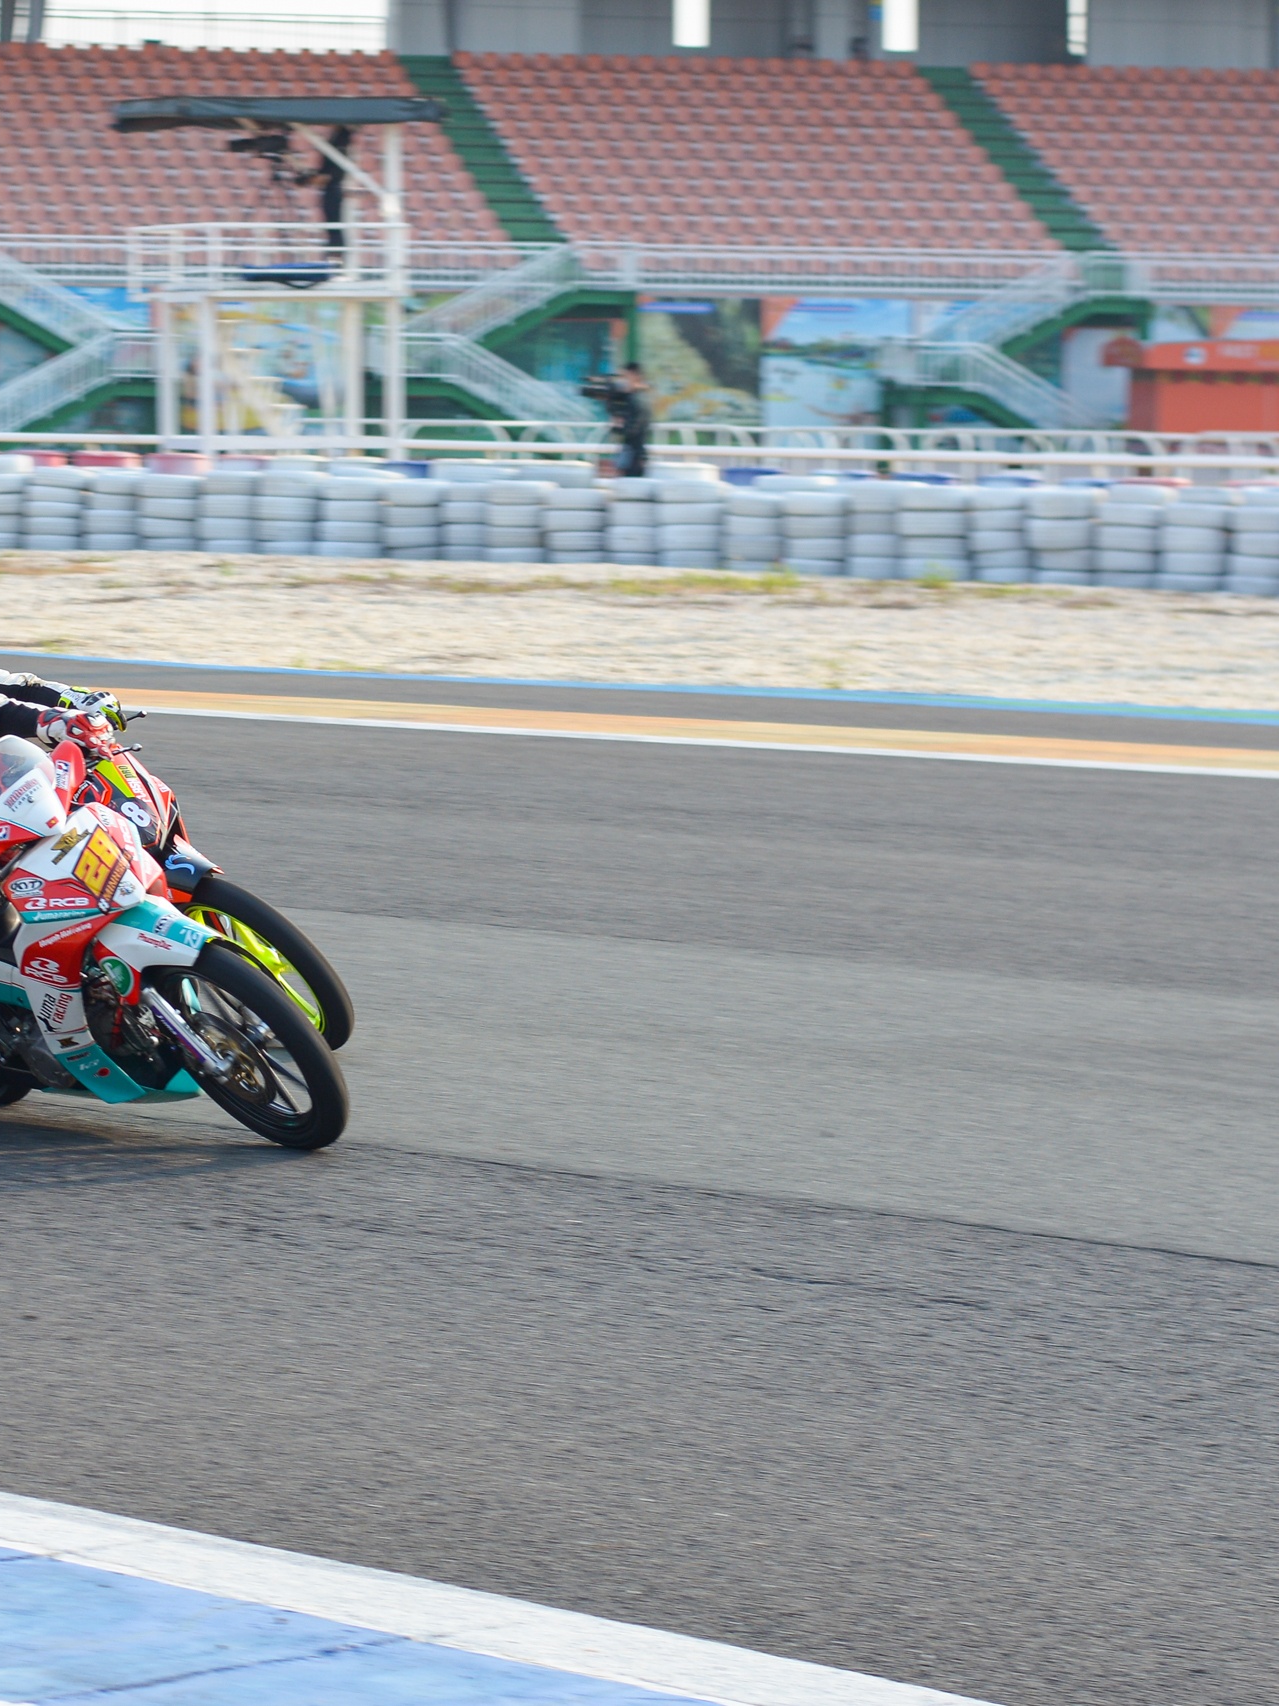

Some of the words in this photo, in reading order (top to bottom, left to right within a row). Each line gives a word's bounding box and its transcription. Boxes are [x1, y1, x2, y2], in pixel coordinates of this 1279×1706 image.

[121, 801, 151, 828] 8
[74, 826, 119, 898] 28
[49, 897, 89, 908] RCB
[24, 966, 68, 984] RCB
[52, 992, 74, 1025] racing
